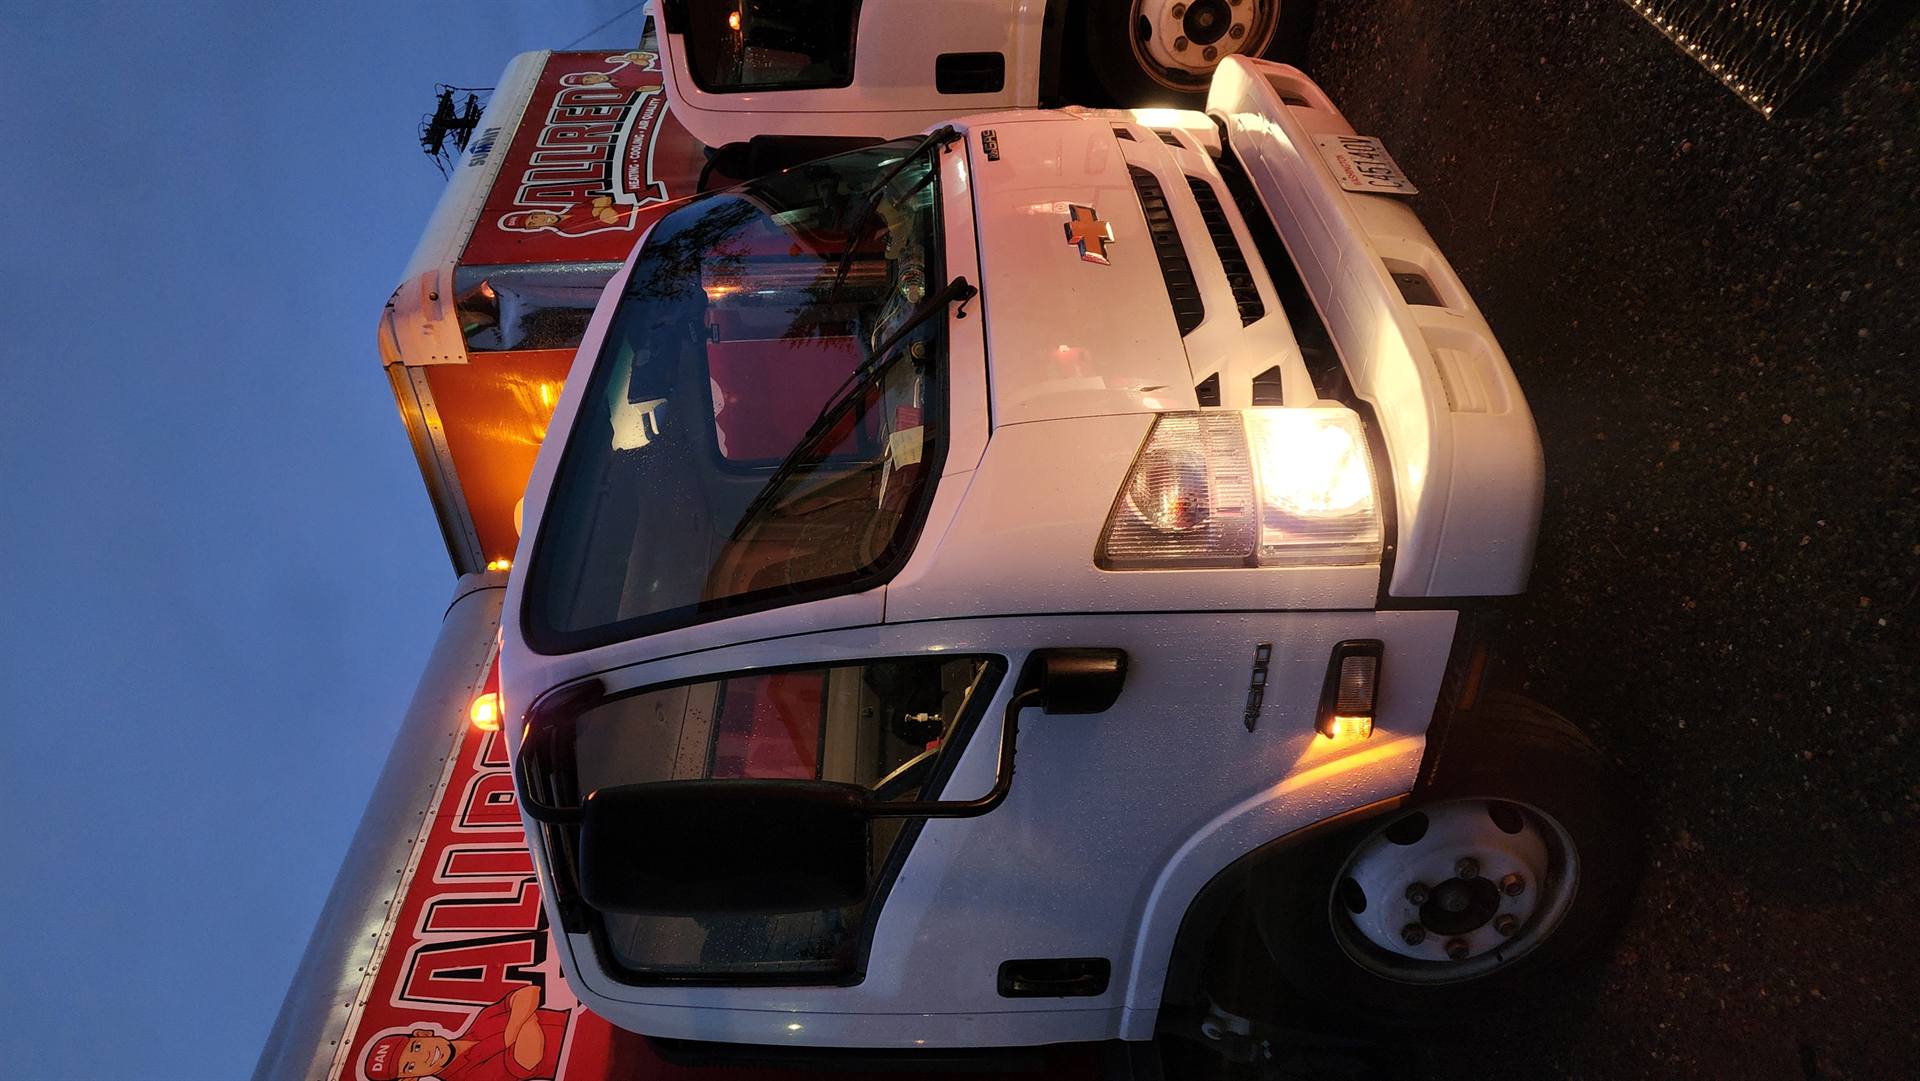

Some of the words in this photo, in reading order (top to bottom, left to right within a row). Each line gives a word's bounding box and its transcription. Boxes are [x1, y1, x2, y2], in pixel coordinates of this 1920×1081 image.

[642, 97, 661, 120] QUALITY
[637, 120, 650, 130] AIR
[468, 127, 501, 167] SUMMIT
[513, 87, 640, 206] ALLRED
[630, 134, 645, 159] COOLING
[628, 164, 640, 190] HEATING
[1244, 644, 1272, 733] 4500
[391, 732, 548, 1007] ALLR
[372, 1043, 390, 1072] DAN
